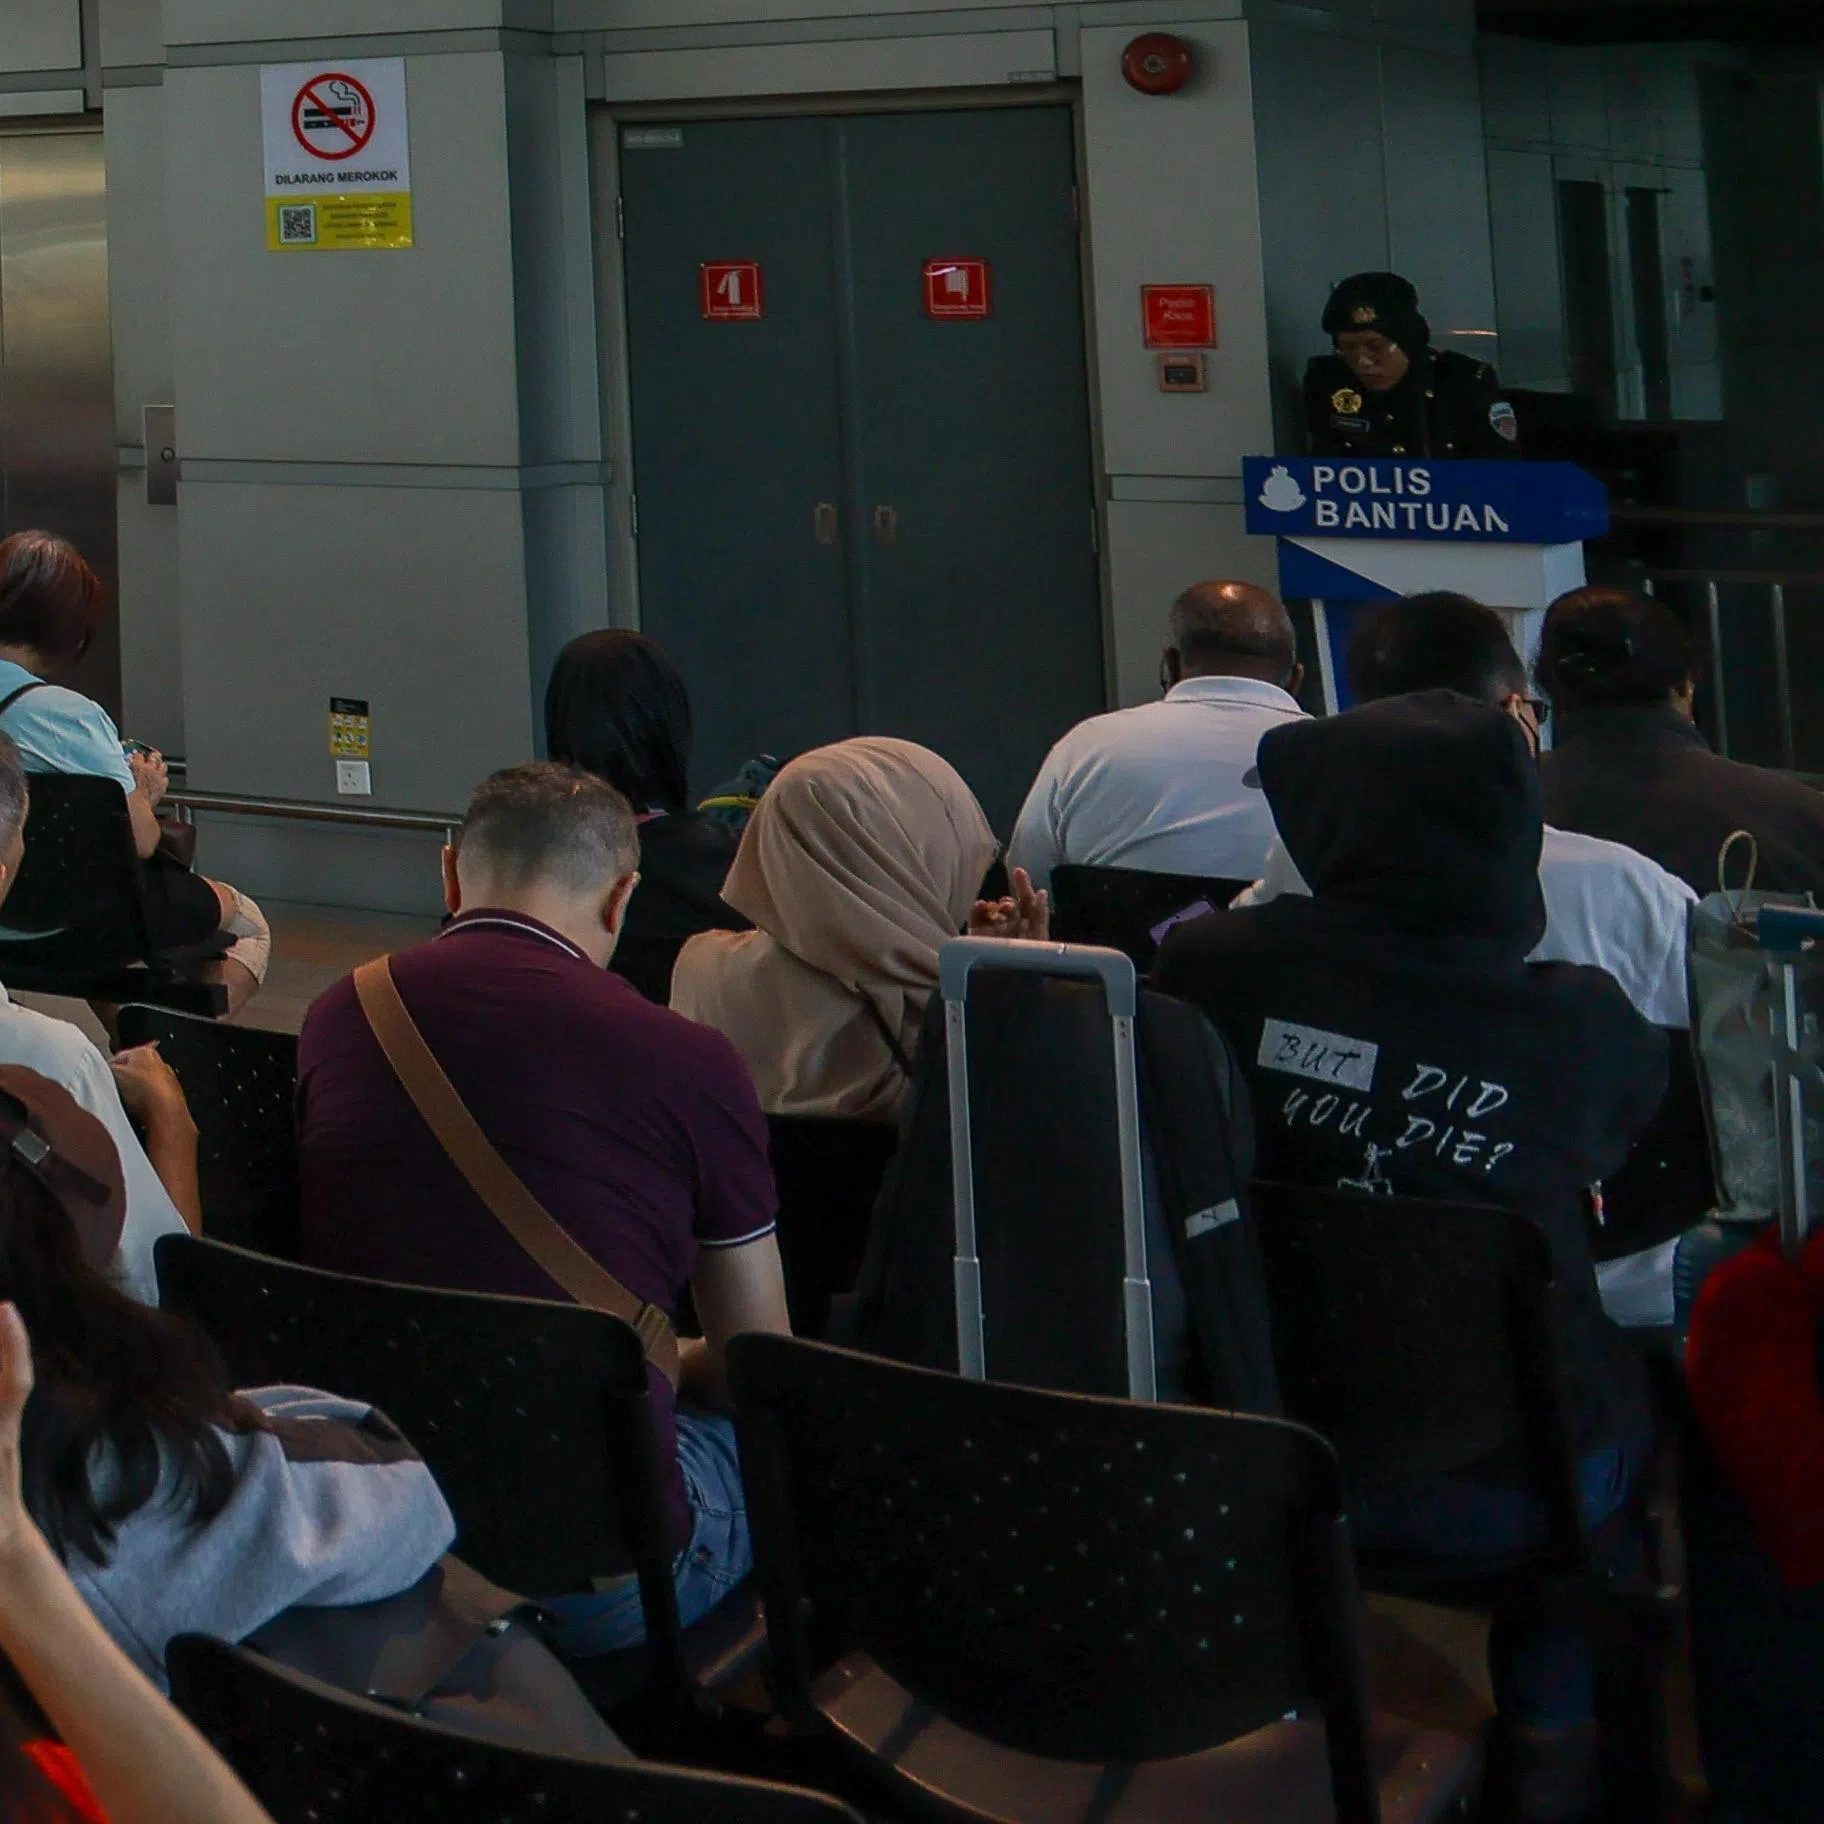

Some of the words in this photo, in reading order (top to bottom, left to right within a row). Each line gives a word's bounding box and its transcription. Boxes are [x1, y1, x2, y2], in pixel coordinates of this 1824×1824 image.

[275, 172, 335, 186] DILARANG
[337, 170, 398, 183] MEROKOK
[1312, 465, 1432, 496] POLIS
[1315, 501, 1510, 534] BANTUAN
[1272, 1032, 1363, 1078] BUT
[1402, 1063, 1513, 1115] DID
[1283, 1088, 1369, 1138] YOU
[1395, 1114, 1515, 1173] DIE?
